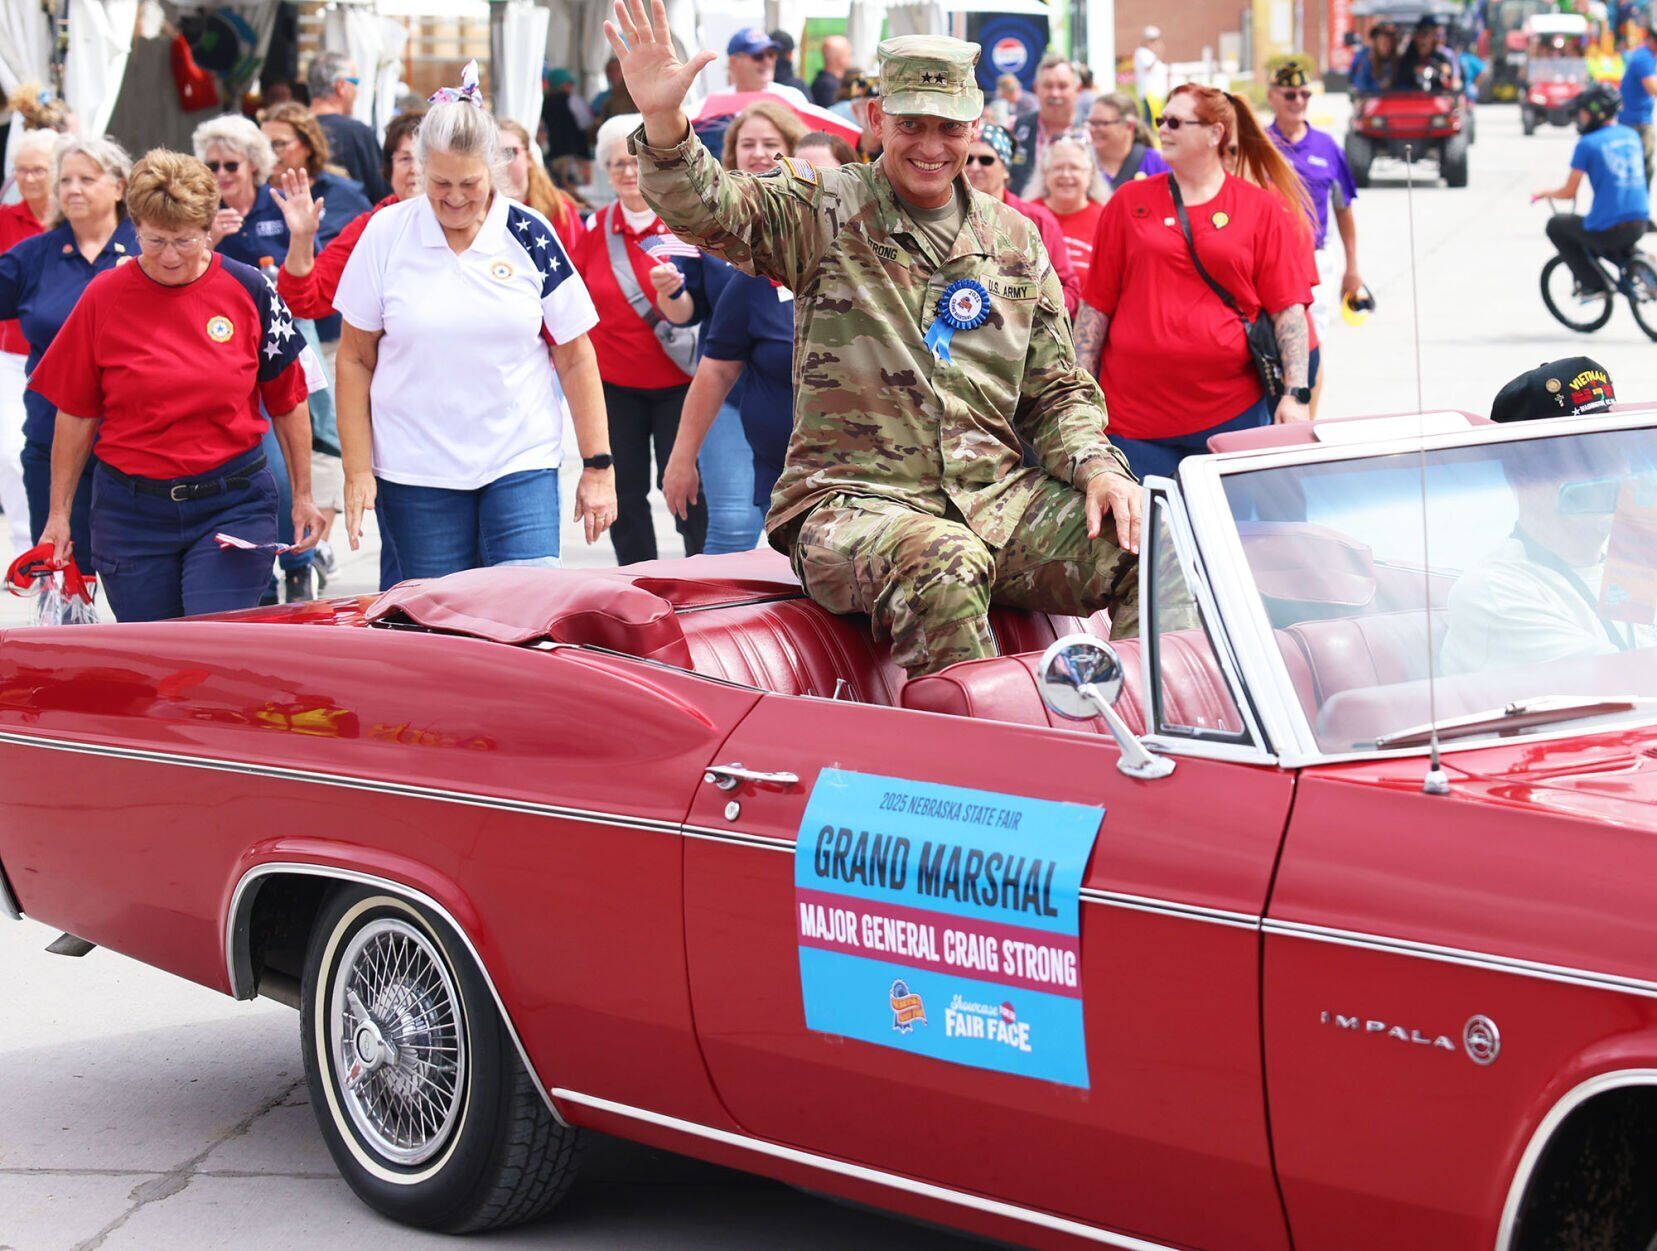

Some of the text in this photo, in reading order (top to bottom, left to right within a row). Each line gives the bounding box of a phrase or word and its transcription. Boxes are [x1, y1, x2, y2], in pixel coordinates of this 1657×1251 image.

[1003, 286, 1028, 299] ARMY
[1569, 370, 1607, 390] VIETNAM
[879, 792, 1023, 831] 2025 NEBRASKA STATE FAIR
[814, 825, 1058, 918] GRAND MARSHAL
[799, 902, 1078, 988] MAJOR GENERAL CRAIG STRONG
[944, 1007, 985, 1038] FAIR
[986, 1016, 1033, 1052] FACE
[1320, 1010, 1456, 1051] IMPALA
